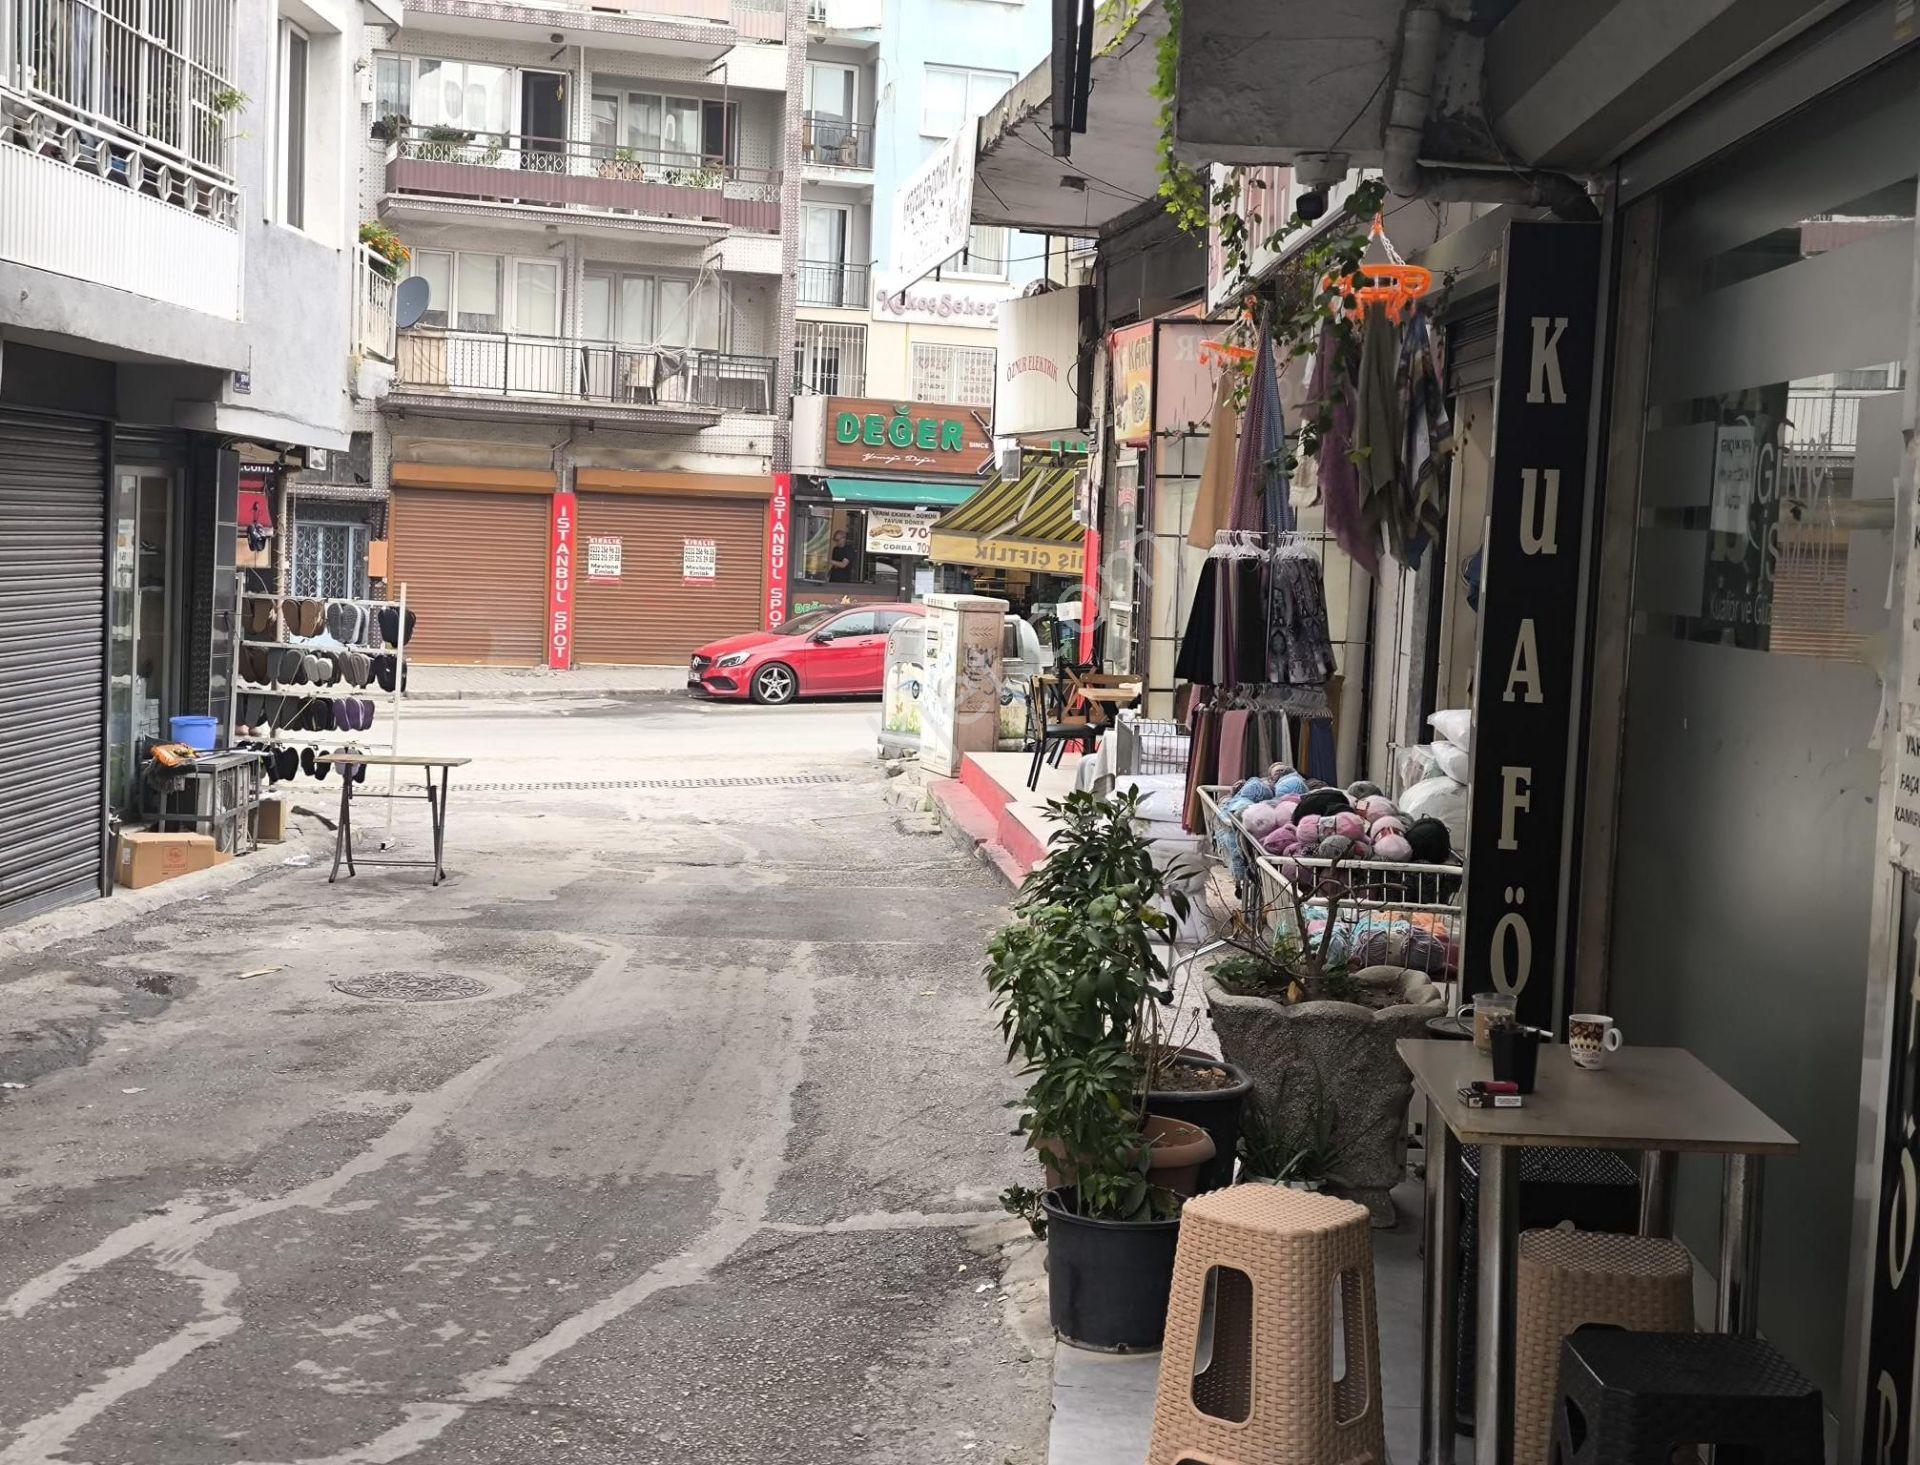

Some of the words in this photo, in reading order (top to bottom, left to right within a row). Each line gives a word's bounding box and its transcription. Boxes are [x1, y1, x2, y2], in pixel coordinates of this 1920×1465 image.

[836, 402, 965, 453] DEĞER
[967, 440, 990, 451] SINCE
[883, 543, 913, 552] ÇORBA
[553, 610, 570, 659] SPOT
